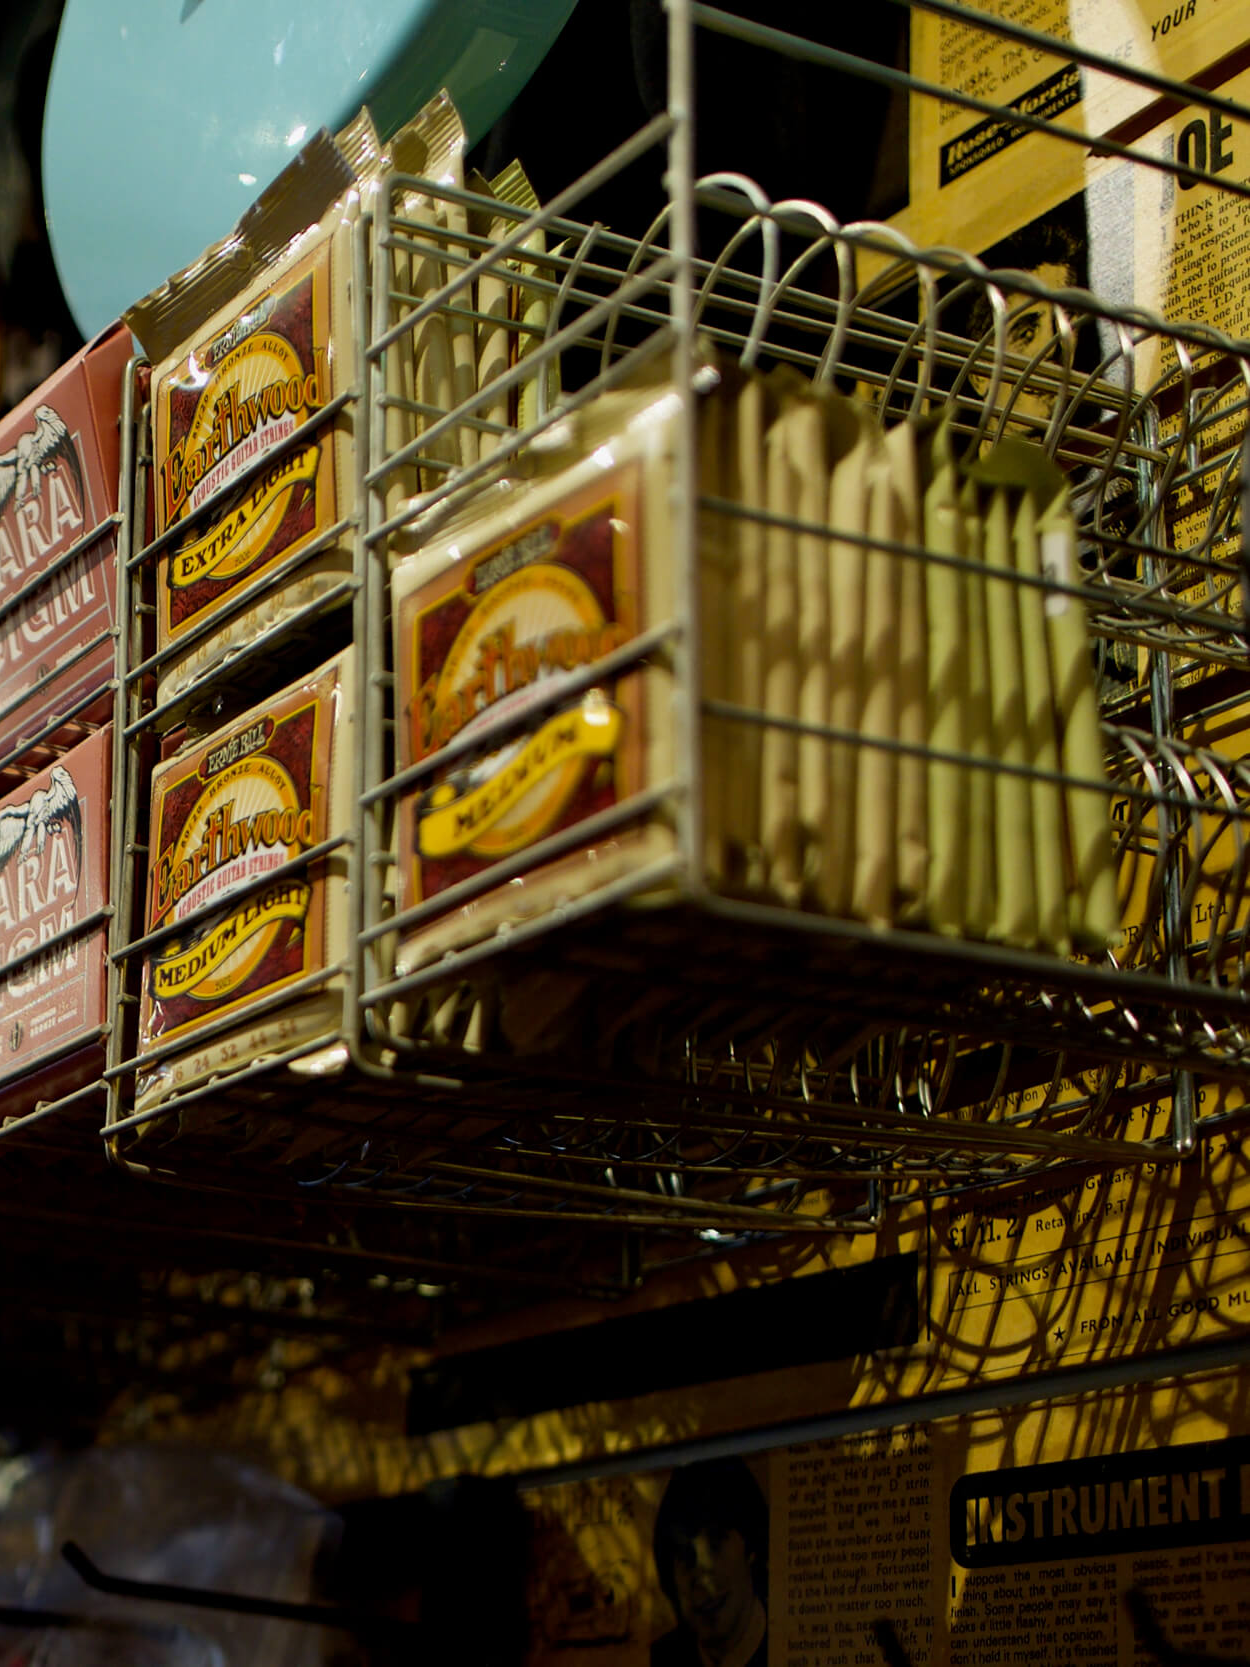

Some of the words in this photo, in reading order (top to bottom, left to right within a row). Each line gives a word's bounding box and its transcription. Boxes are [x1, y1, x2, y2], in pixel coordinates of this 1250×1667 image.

[1151, 0, 1196, 41] YOUR
[1175, 196, 1212, 227] THINK
[1180, 219, 1200, 235] who
[1206, 211, 1213, 222] is
[1190, 224, 1213, 243] back
[1219, 216, 1229, 226] to
[1200, 223, 1236, 250] respect
[1181, 267, 1203, 287] used
[1207, 262, 1217, 273] to
[1182, 251, 1215, 273] singer.
[1213, 291, 1236, 308] T.D.
[1213, 307, 1231, 322] one
[1235, 296, 1246, 311] of
[1224, 311, 1243, 329] still
[261, 340, 290, 363] ALLOY
[161, 347, 325, 529] Earthwood
[193, 460, 230, 509] ACOUSTIC
[231, 440, 258, 471] GUITAR
[260, 419, 294, 449] STRINGS
[181, 510, 246, 577] EXTRA
[251, 449, 310, 511] LIGHT
[207, 735, 240, 774] ERNIE
[209, 762, 251, 798] BRONZE
[259, 764, 287, 791] ALLOY
[454, 716, 580, 839] MEDIUM
[150, 784, 324, 931] Earthwood
[177, 880, 215, 921] ACOUSTIC
[217, 866, 247, 890] GUITAR
[248, 853, 284, 878] STRINGS
[158, 916, 237, 989] MEDIUM
[243, 885, 310, 927] LIGHT
[1141, 1101, 1165, 1117] No.
[1085, 1169, 1133, 1191] Guitar.
[956, 1283, 981, 1298] ALL
[989, 1268, 1049, 1290] STRINGS
[1056, 1245, 1142, 1277] AVAILABLE
[1081, 1315, 1123, 1334] FROM
[1132, 1308, 1161, 1323] ALL
[1168, 1296, 1220, 1318] GOOD
[896, 1463, 912, 1477] got
[966, 1468, 1227, 1546] INSTRUMENT
[876, 1531, 893, 1543] out
[895, 1528, 906, 1540] of
[1180, 1554, 1201, 1567] and
[861, 1578, 898, 1593] number
[965, 1573, 1006, 1587] suppose
[1014, 1570, 1030, 1582] the
[1038, 1567, 1065, 1580] most
[1073, 1563, 1117, 1577] obvious
[874, 1598, 892, 1609] too
[896, 1593, 926, 1608] much.
[963, 1588, 987, 1602] thing
[993, 1586, 1023, 1599] about
[1029, 1584, 1046, 1596] the
[1052, 1581, 1082, 1596] guitar
[1089, 1579, 1097, 1590] is
[1104, 1578, 1117, 1590] its
[951, 1605, 979, 1618] finish.
[984, 1602, 1014, 1616] Some
[1018, 1599, 1054, 1614] people
[1058, 1597, 1081, 1610] may
[1086, 1595, 1104, 1608] say
[1110, 1593, 1117, 1605] it
[950, 1621, 976, 1634] looks
[980, 1622, 986, 1631] a
[989, 1618, 1012, 1632] little
[1016, 1615, 1049, 1629] flashy,
[1055, 1612, 1075, 1626] and
[1080, 1611, 1108, 1624] while
[950, 1638, 968, 1650] can
[973, 1632, 1031, 1647] understand
[1036, 1631, 1056, 1644] that
[950, 1651, 976, 1665] don't
[979, 1650, 1000, 1663] hold
[1004, 1649, 1010, 1661] it
[1014, 1647, 1051, 1661] myself.
[1055, 1645, 1071, 1659] It's
[1074, 1643, 1118, 1658] finished
